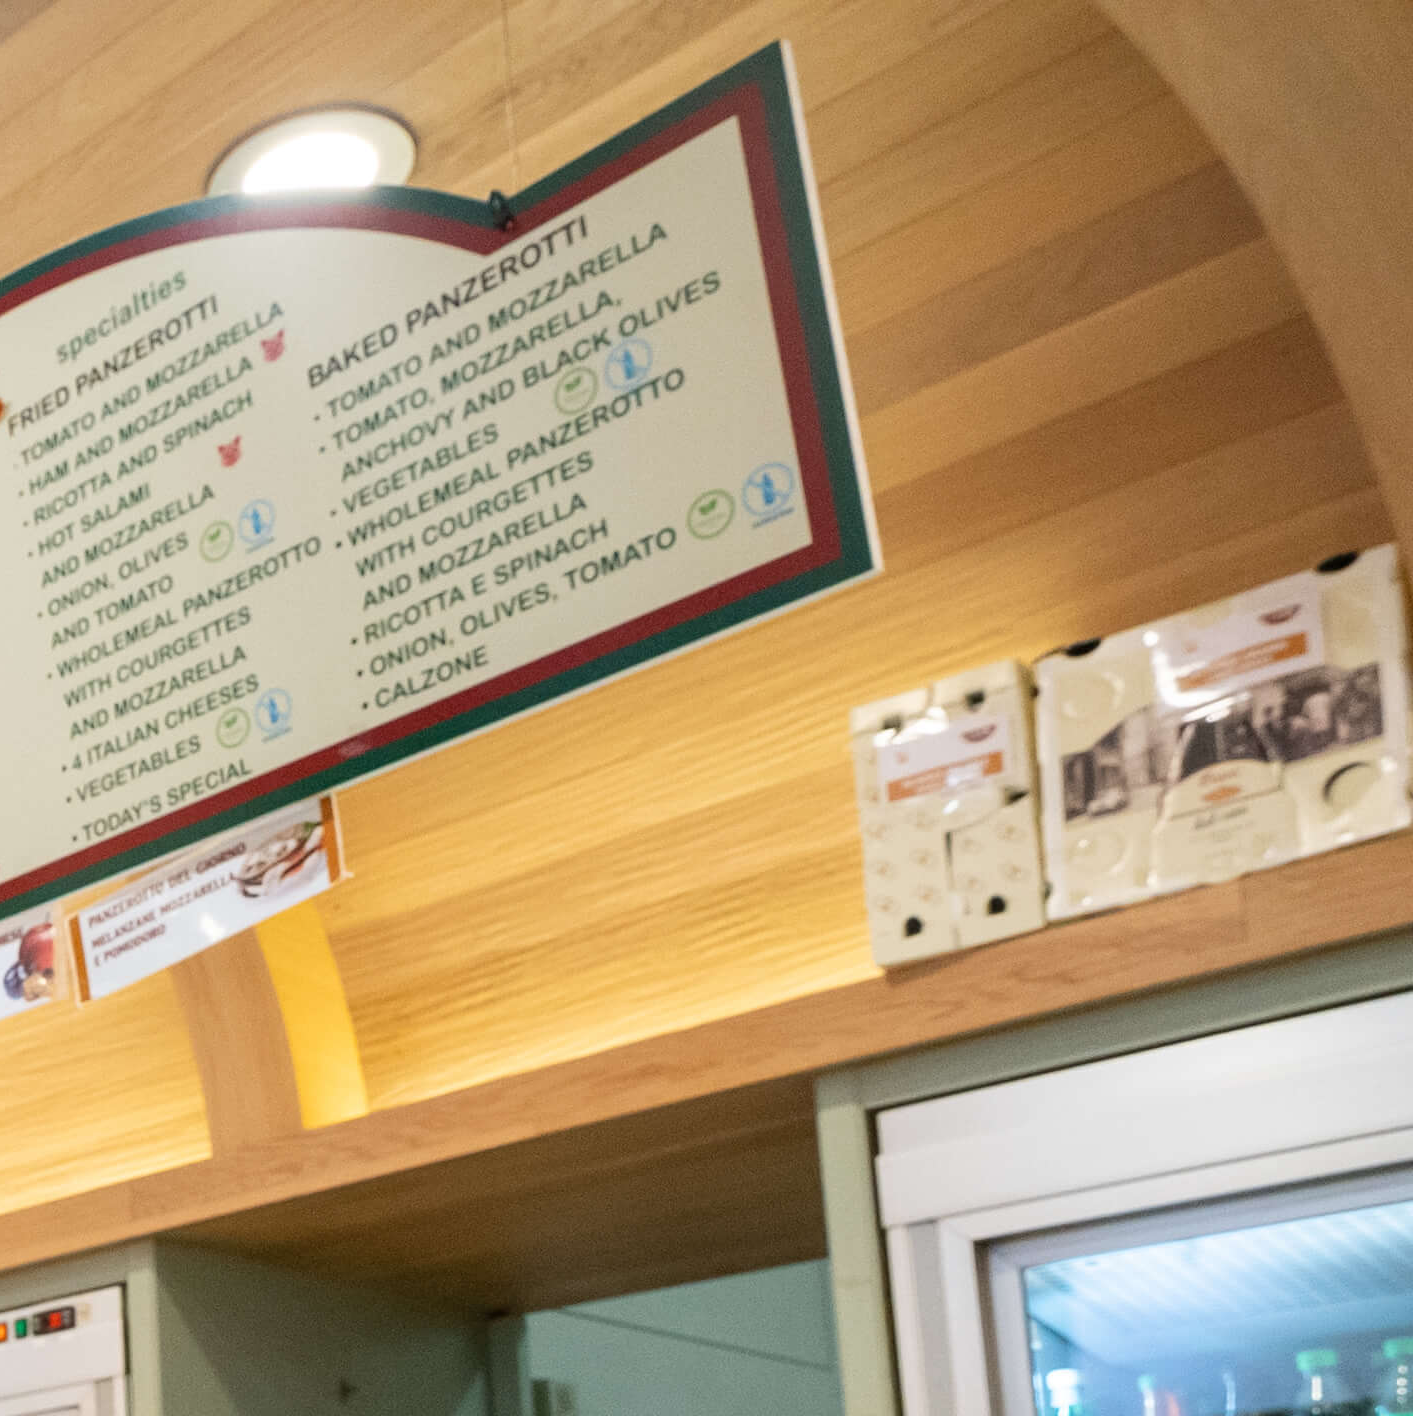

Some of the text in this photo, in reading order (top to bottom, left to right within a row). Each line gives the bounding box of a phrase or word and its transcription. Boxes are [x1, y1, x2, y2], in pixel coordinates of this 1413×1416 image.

[57, 270, 188, 364] specialties
[307, 215, 587, 388] BAKED PANZEROTTI
[328, 220, 667, 418] TOMATO AND MOZZARELLA
[7, 293, 218, 436] FRIED PANZEROTTI
[21, 300, 283, 465] TOMATO AND MOZZARELLA
[28, 354, 252, 494] HAM AND MOZZARELLA
[334, 283, 621, 451] TOMATO, MOZZARELLA,
[340, 269, 721, 480] ANCHOVY AND BLACK OLIVES
[33, 389, 252, 525] RICOTTA AND SPINACH
[342, 422, 498, 514] VEGETABLES
[348, 366, 684, 546] WHOLEMEAL PANZEROTTO
[356, 449, 593, 577] WITH COURGETTES
[38, 482, 150, 555] HOT SALAMI
[41, 482, 214, 587] AND MOZZARELLA
[47, 531, 188, 619] ONION, OLIVES
[362, 491, 585, 609] AND MOZZARELLA
[50, 573, 173, 648] AND TOMATO
[57, 534, 321, 678] WHOLEMEAL PANZEROTTO
[364, 518, 607, 644] RICOTTA E SPINACH
[370, 525, 676, 679] ONION, OLIVES, TOMATO
[63, 605, 250, 708] WITH COURGETTES
[69, 644, 245, 738] AND MOZZARELLA
[375, 646, 487, 708] CALZONE
[71, 673, 258, 770] 4 ITALIAN CHEESES
[76, 734, 200, 803] VEGETABLES
[82, 756, 251, 841] TODAY'S SPECIAL
